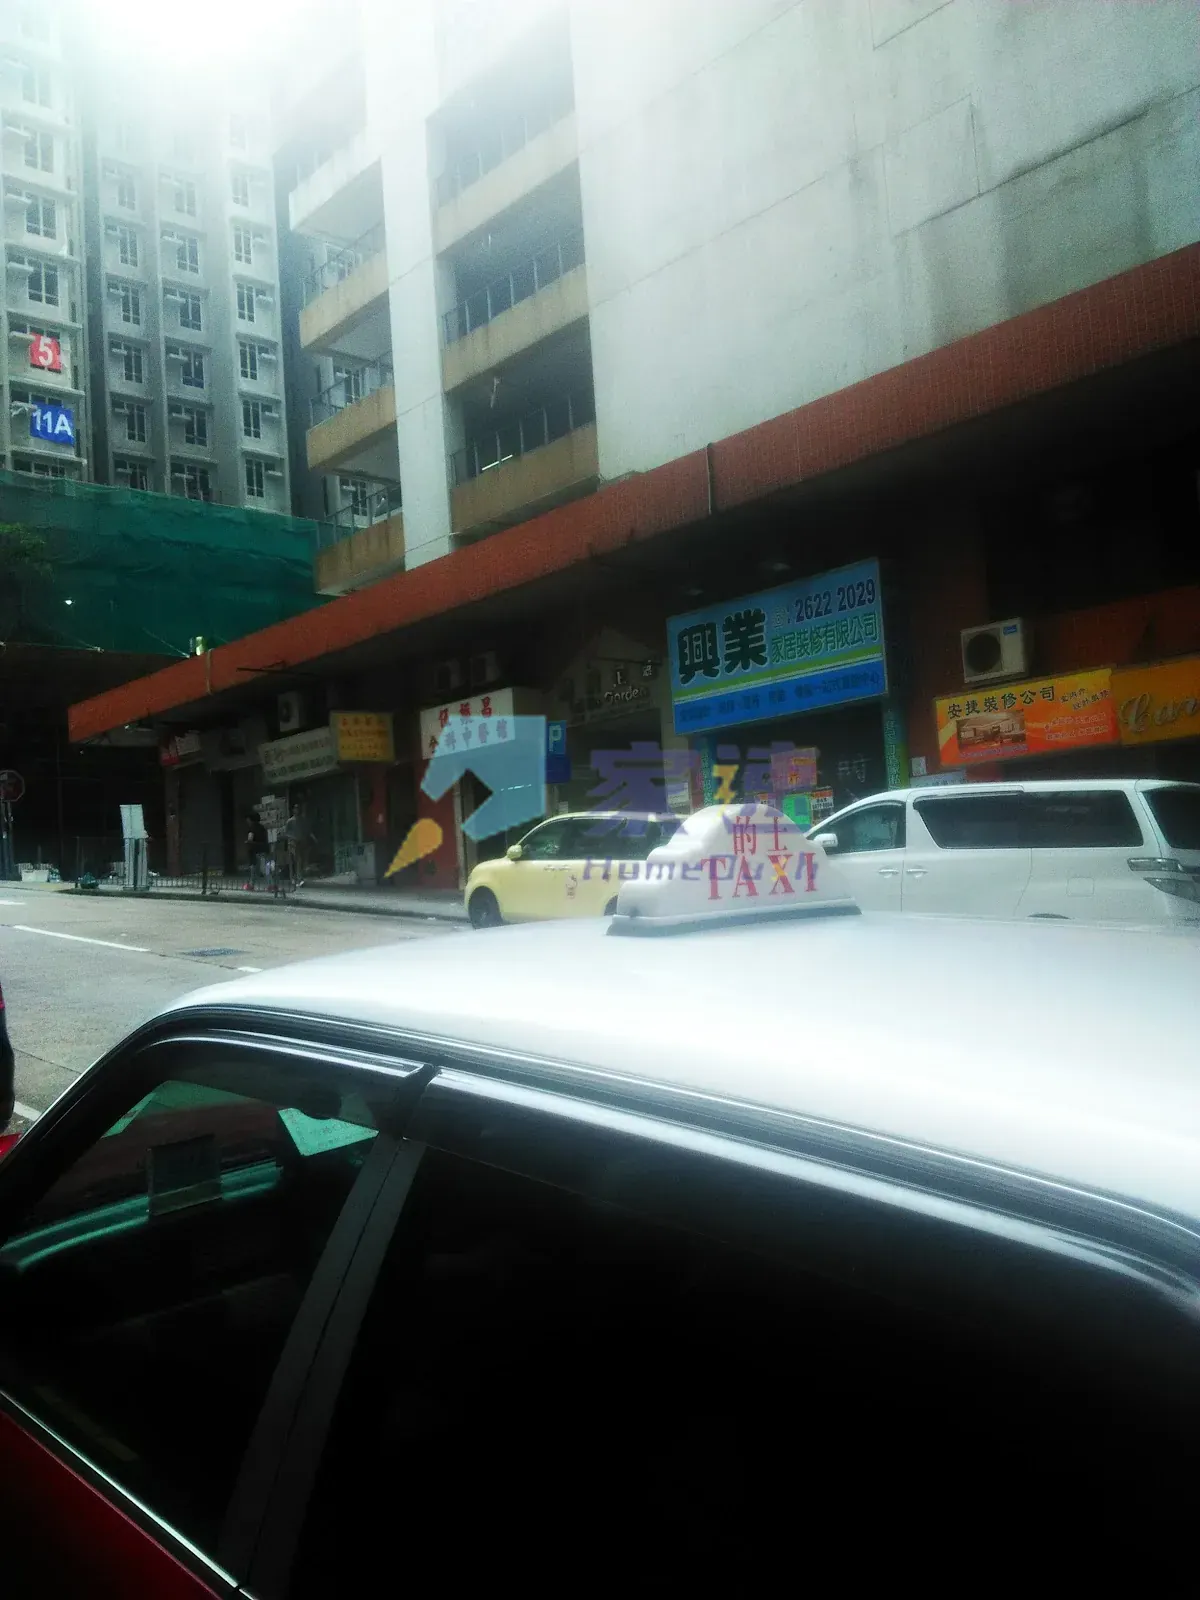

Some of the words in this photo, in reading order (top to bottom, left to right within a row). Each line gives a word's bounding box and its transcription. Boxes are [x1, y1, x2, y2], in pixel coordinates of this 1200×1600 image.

[38, 337, 54, 366] 5
[32, 409, 73, 437] 11A
[794, 590, 833, 623] 2622
[836, 578, 877, 612] 2029
[676, 607, 768, 685] 興業
[770, 611, 880, 665] 家居裝修有限公司
[947, 685, 1057, 720] 安捷裝修公司
[733, 815, 789, 855] 的士
[700, 852, 818, 900] TAXI
